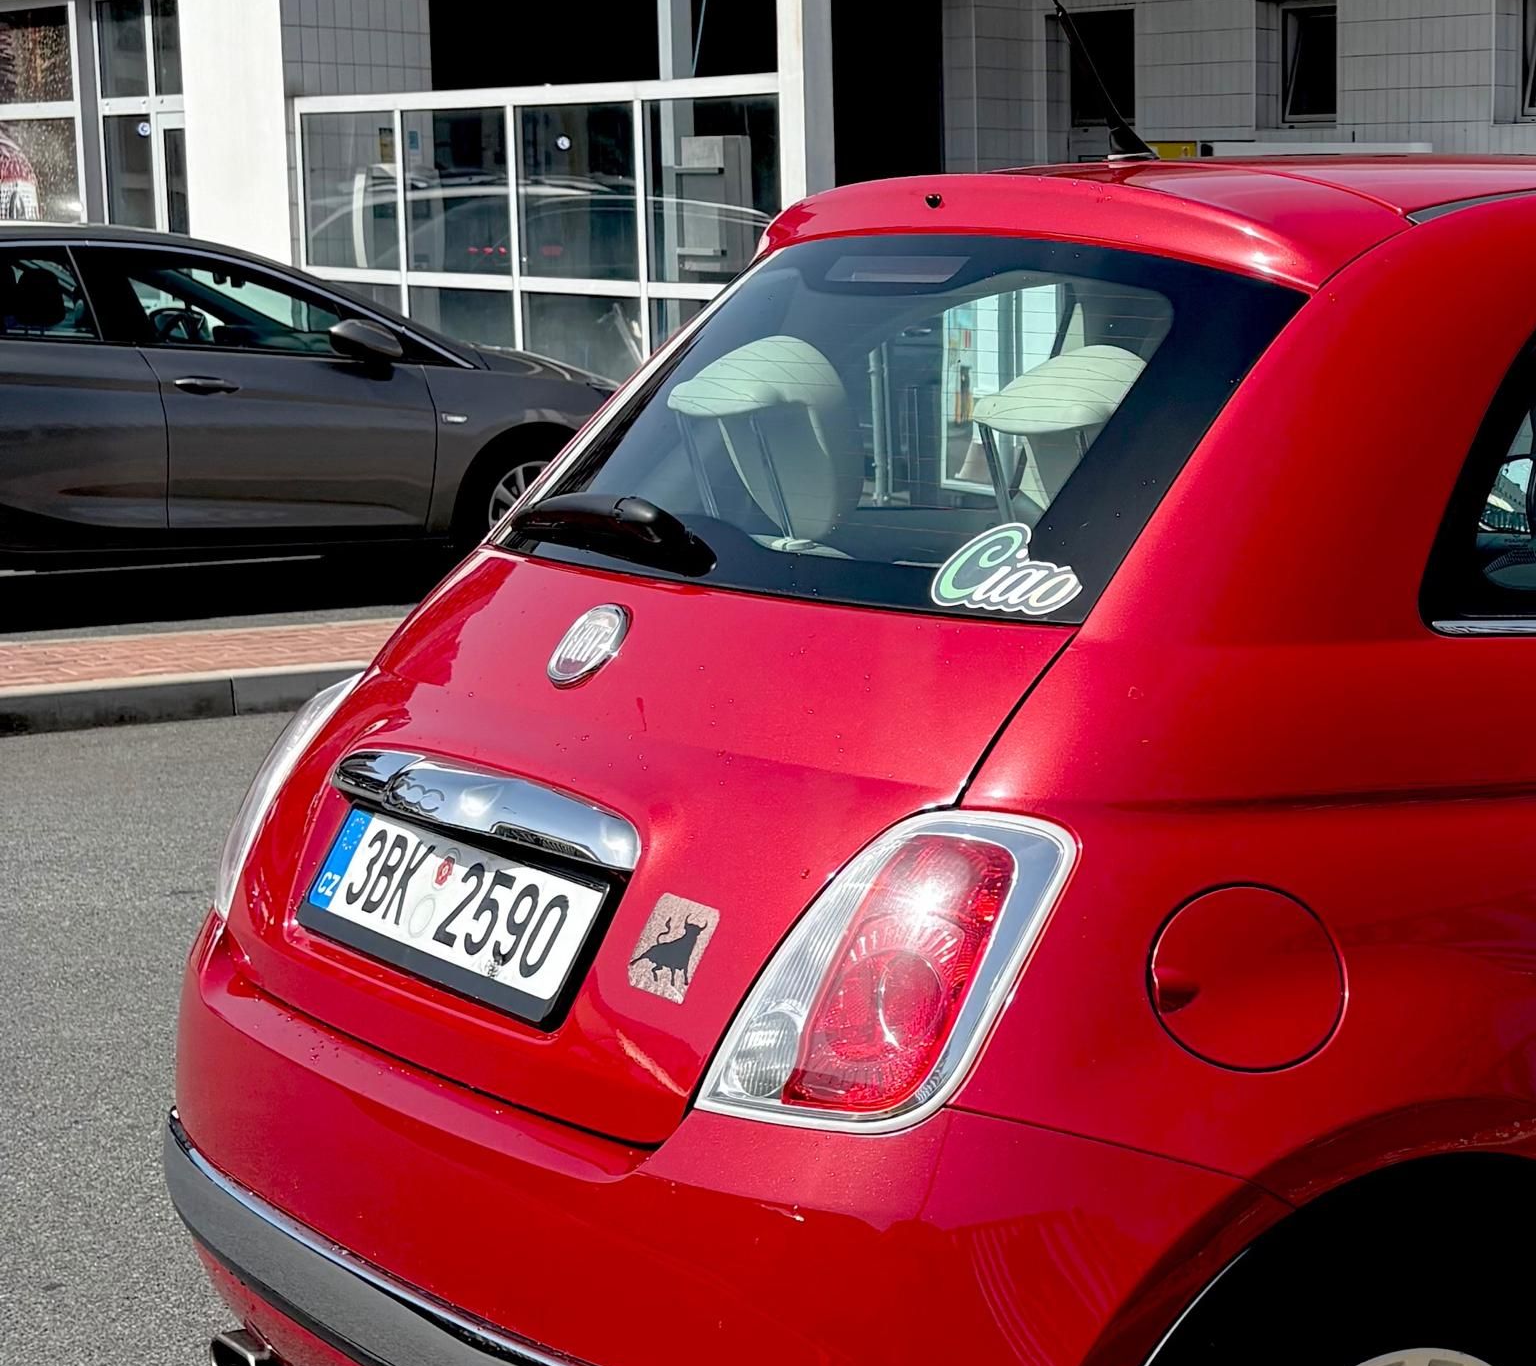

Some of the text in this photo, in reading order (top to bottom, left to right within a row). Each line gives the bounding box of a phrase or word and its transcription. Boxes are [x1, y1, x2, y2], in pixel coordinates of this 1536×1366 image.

[940, 530, 1080, 607] Ciao
[317, 871, 341, 897] CZ
[345, 828, 569, 979] 3BK 2590
